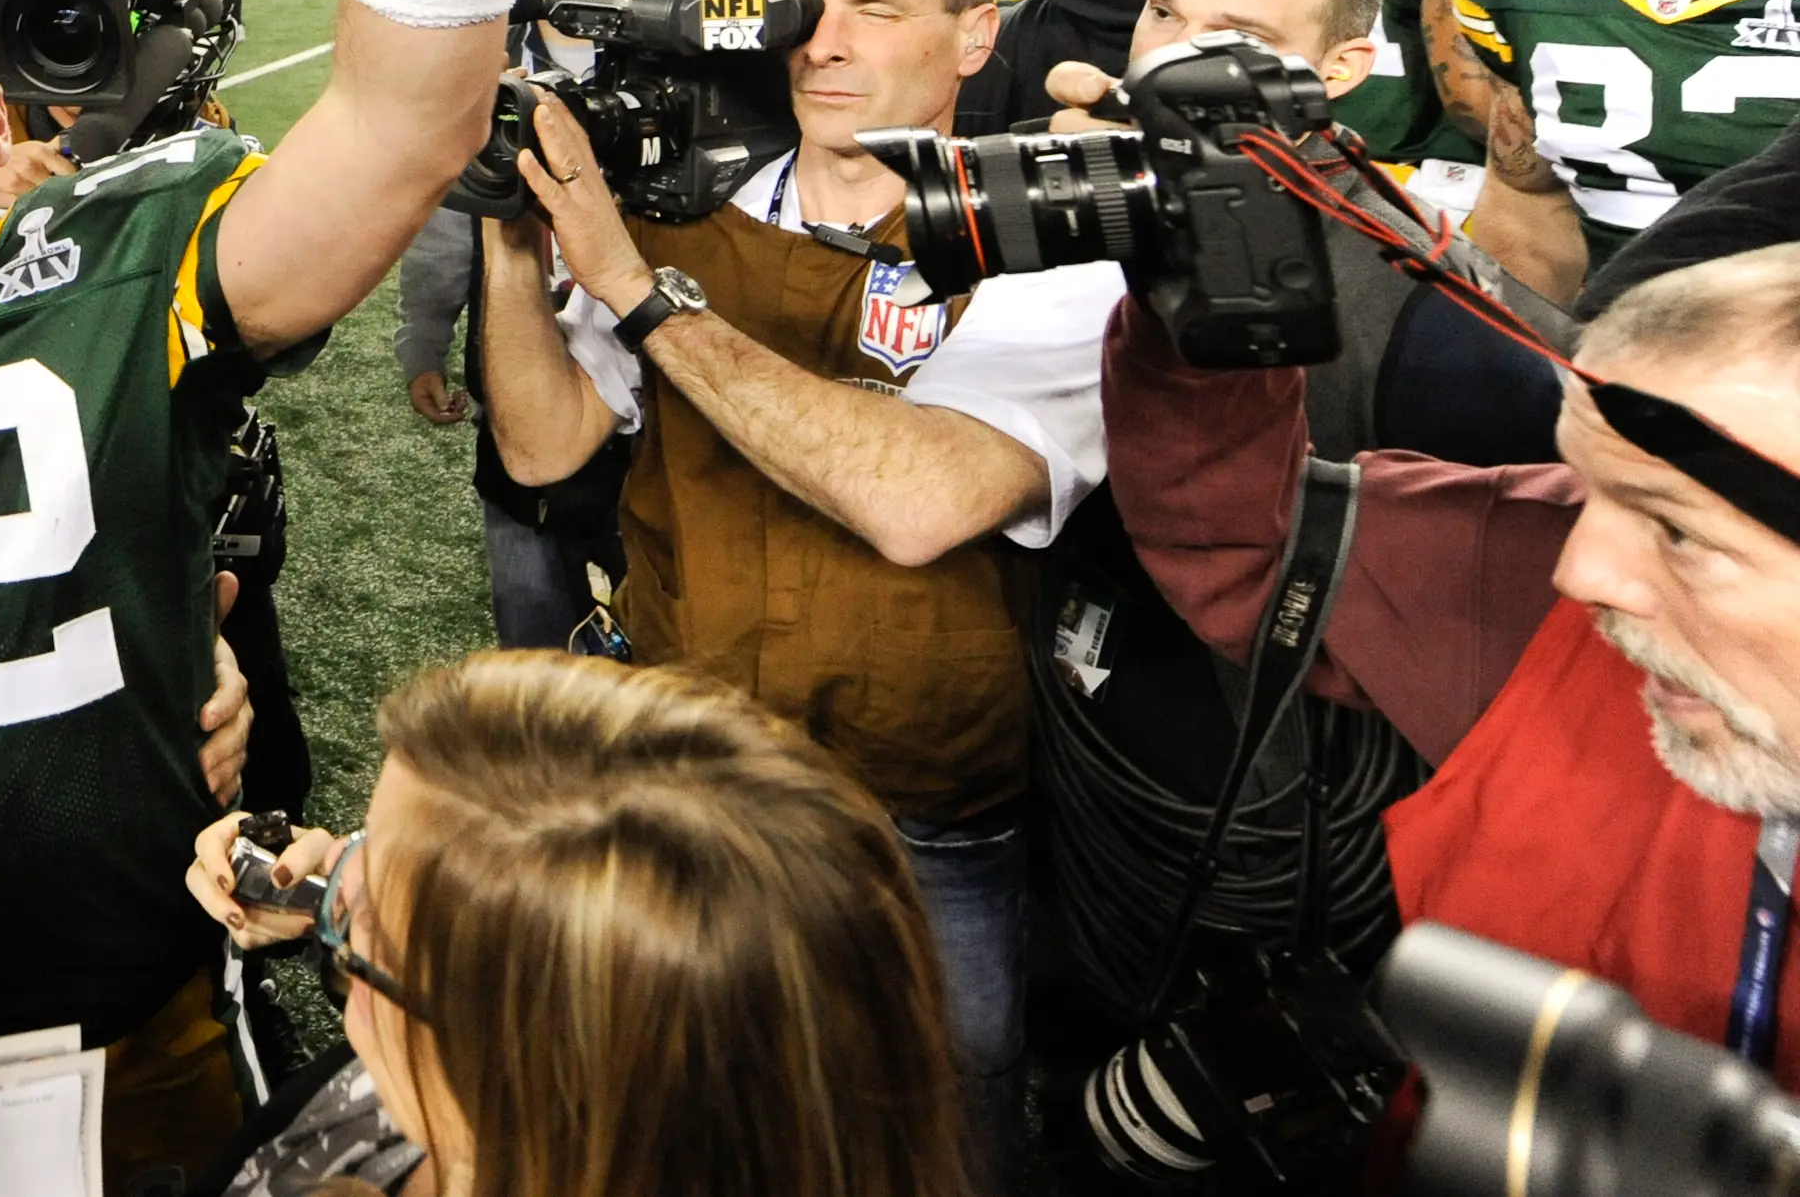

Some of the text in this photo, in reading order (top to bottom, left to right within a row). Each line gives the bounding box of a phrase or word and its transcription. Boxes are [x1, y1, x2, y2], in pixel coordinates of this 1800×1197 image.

[703, 27, 763, 51] FOX
[640, 136, 661, 167] M
[865, 298, 932, 356] NFL
